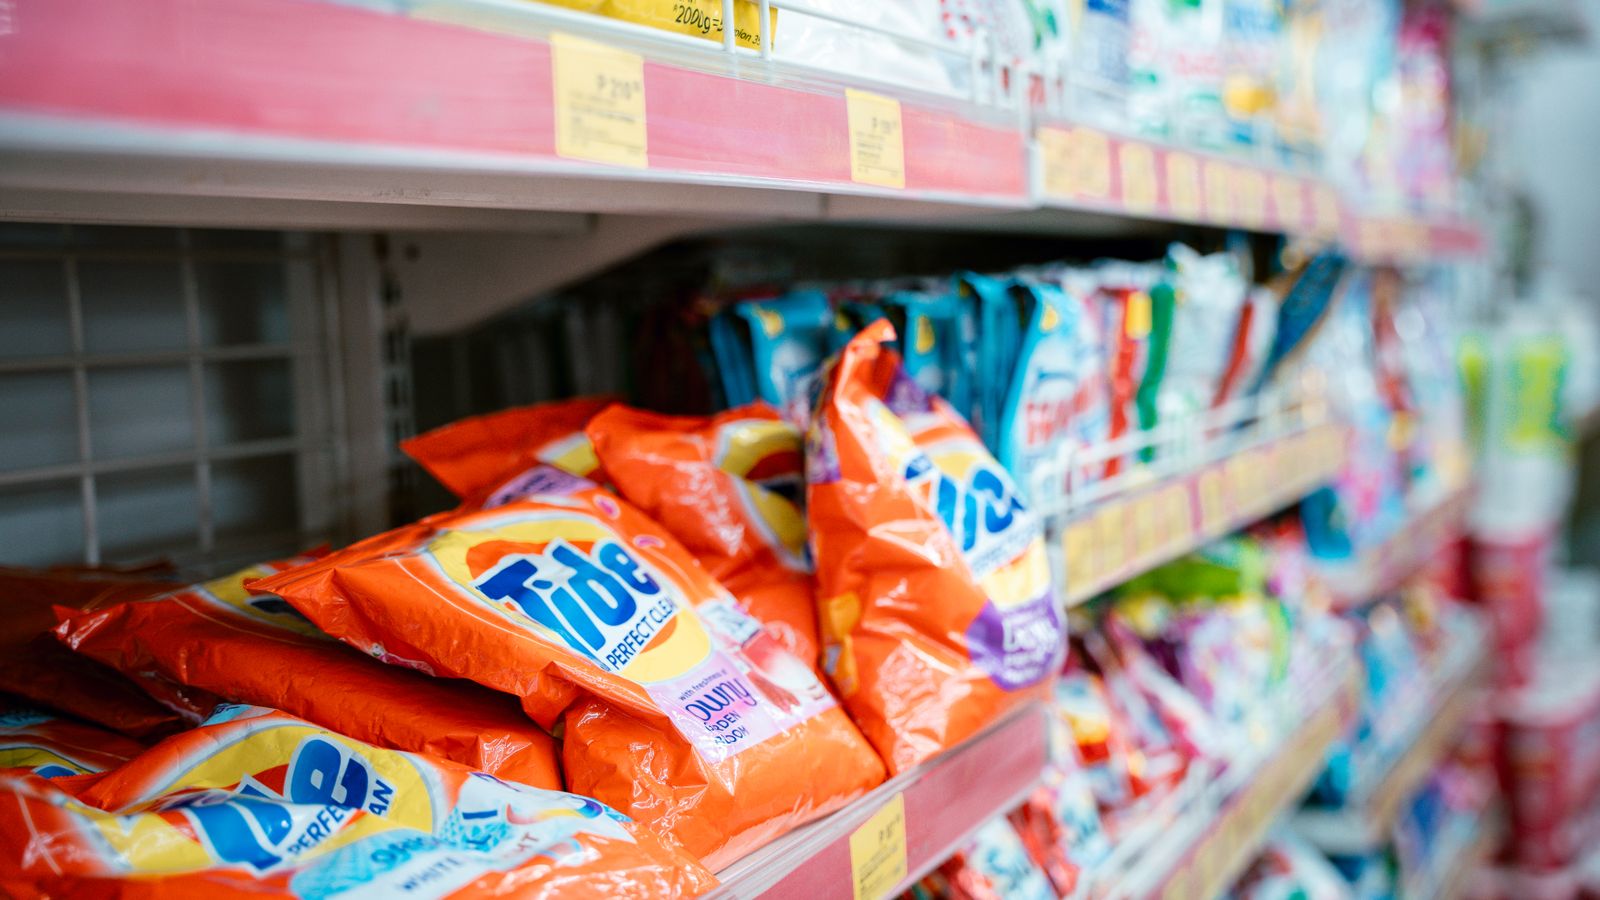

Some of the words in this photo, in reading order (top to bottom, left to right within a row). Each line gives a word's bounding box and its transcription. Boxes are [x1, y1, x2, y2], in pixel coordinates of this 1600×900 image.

[475, 542, 660, 673] Tide
[605, 615, 656, 670] PERFECT
[685, 677, 757, 722] owny
